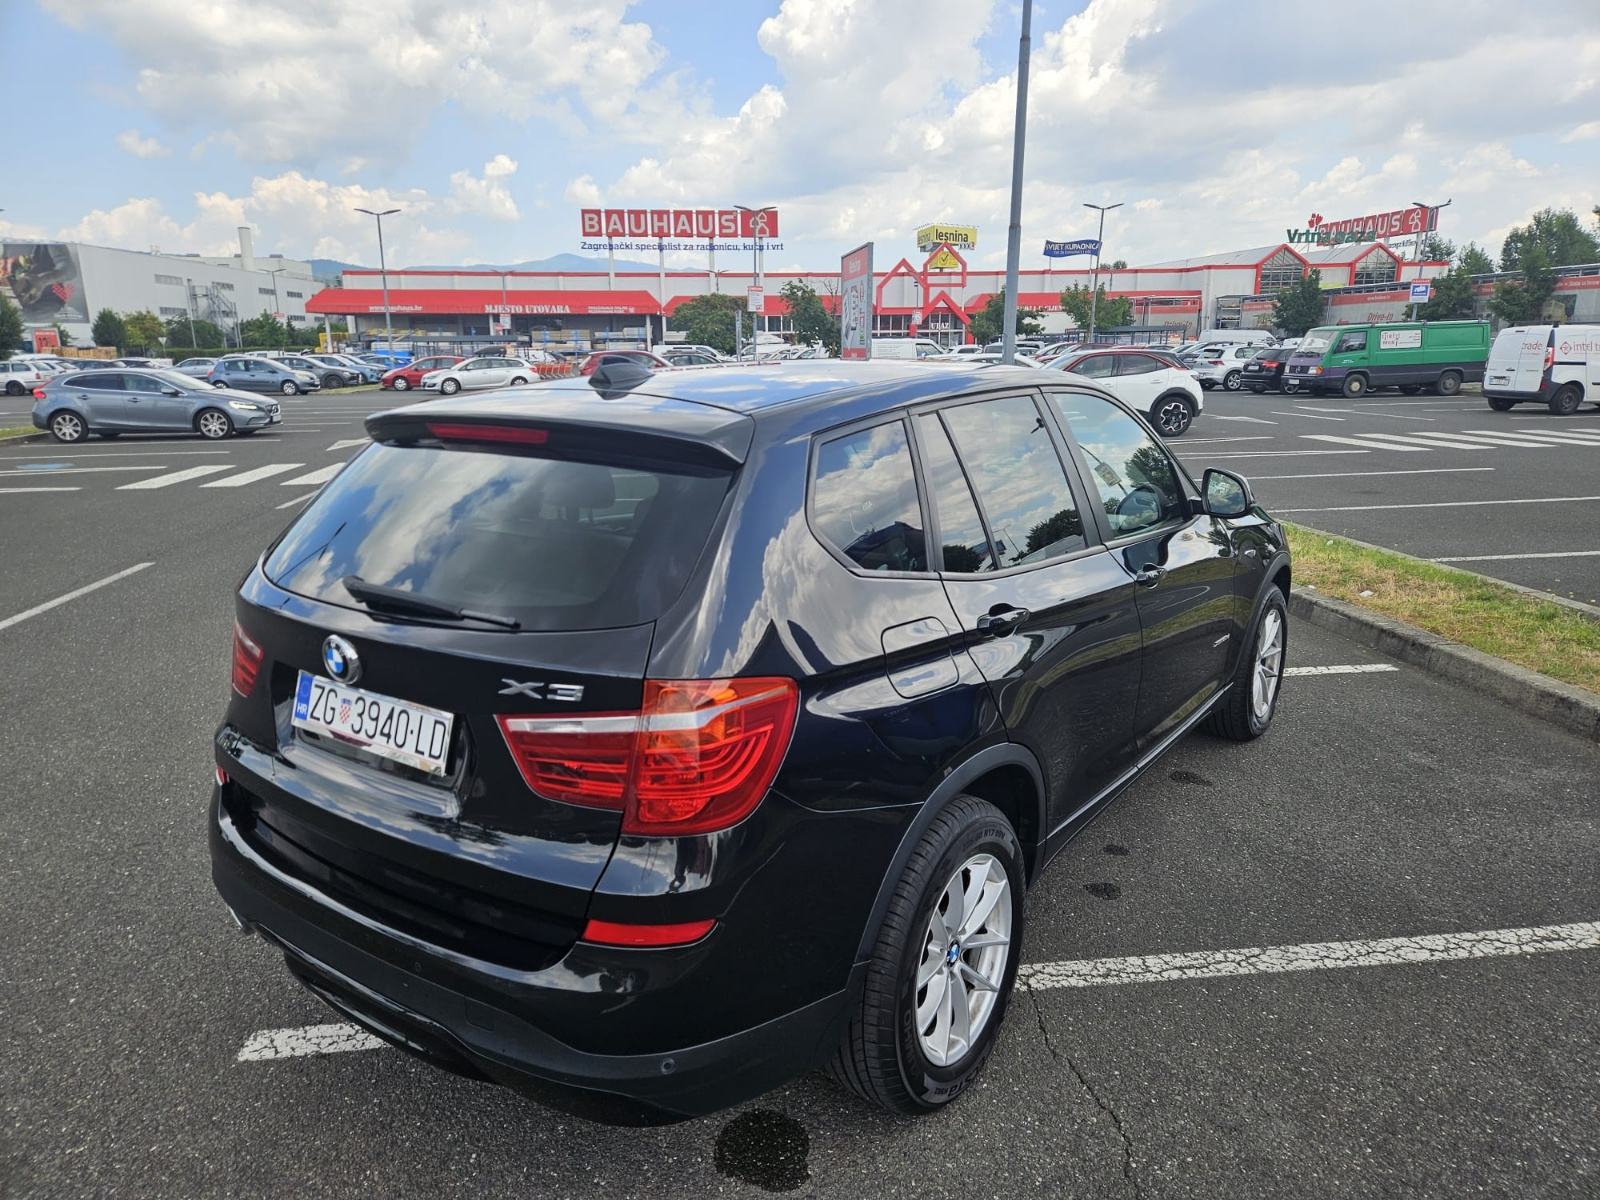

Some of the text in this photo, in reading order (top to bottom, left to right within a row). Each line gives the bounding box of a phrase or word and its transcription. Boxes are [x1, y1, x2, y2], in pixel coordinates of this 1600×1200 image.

[583, 213, 736, 234] BAUHAUS
[935, 228, 969, 243] lesnina
[772, 243, 784, 251] vrt
[484, 304, 571, 314] MJESTO UTOVARA
[1521, 341, 1543, 351] trade
[1573, 341, 1593, 352] intel
[497, 678, 585, 702] X3
[296, 703, 308, 715] HR
[310, 684, 338, 725] ZG
